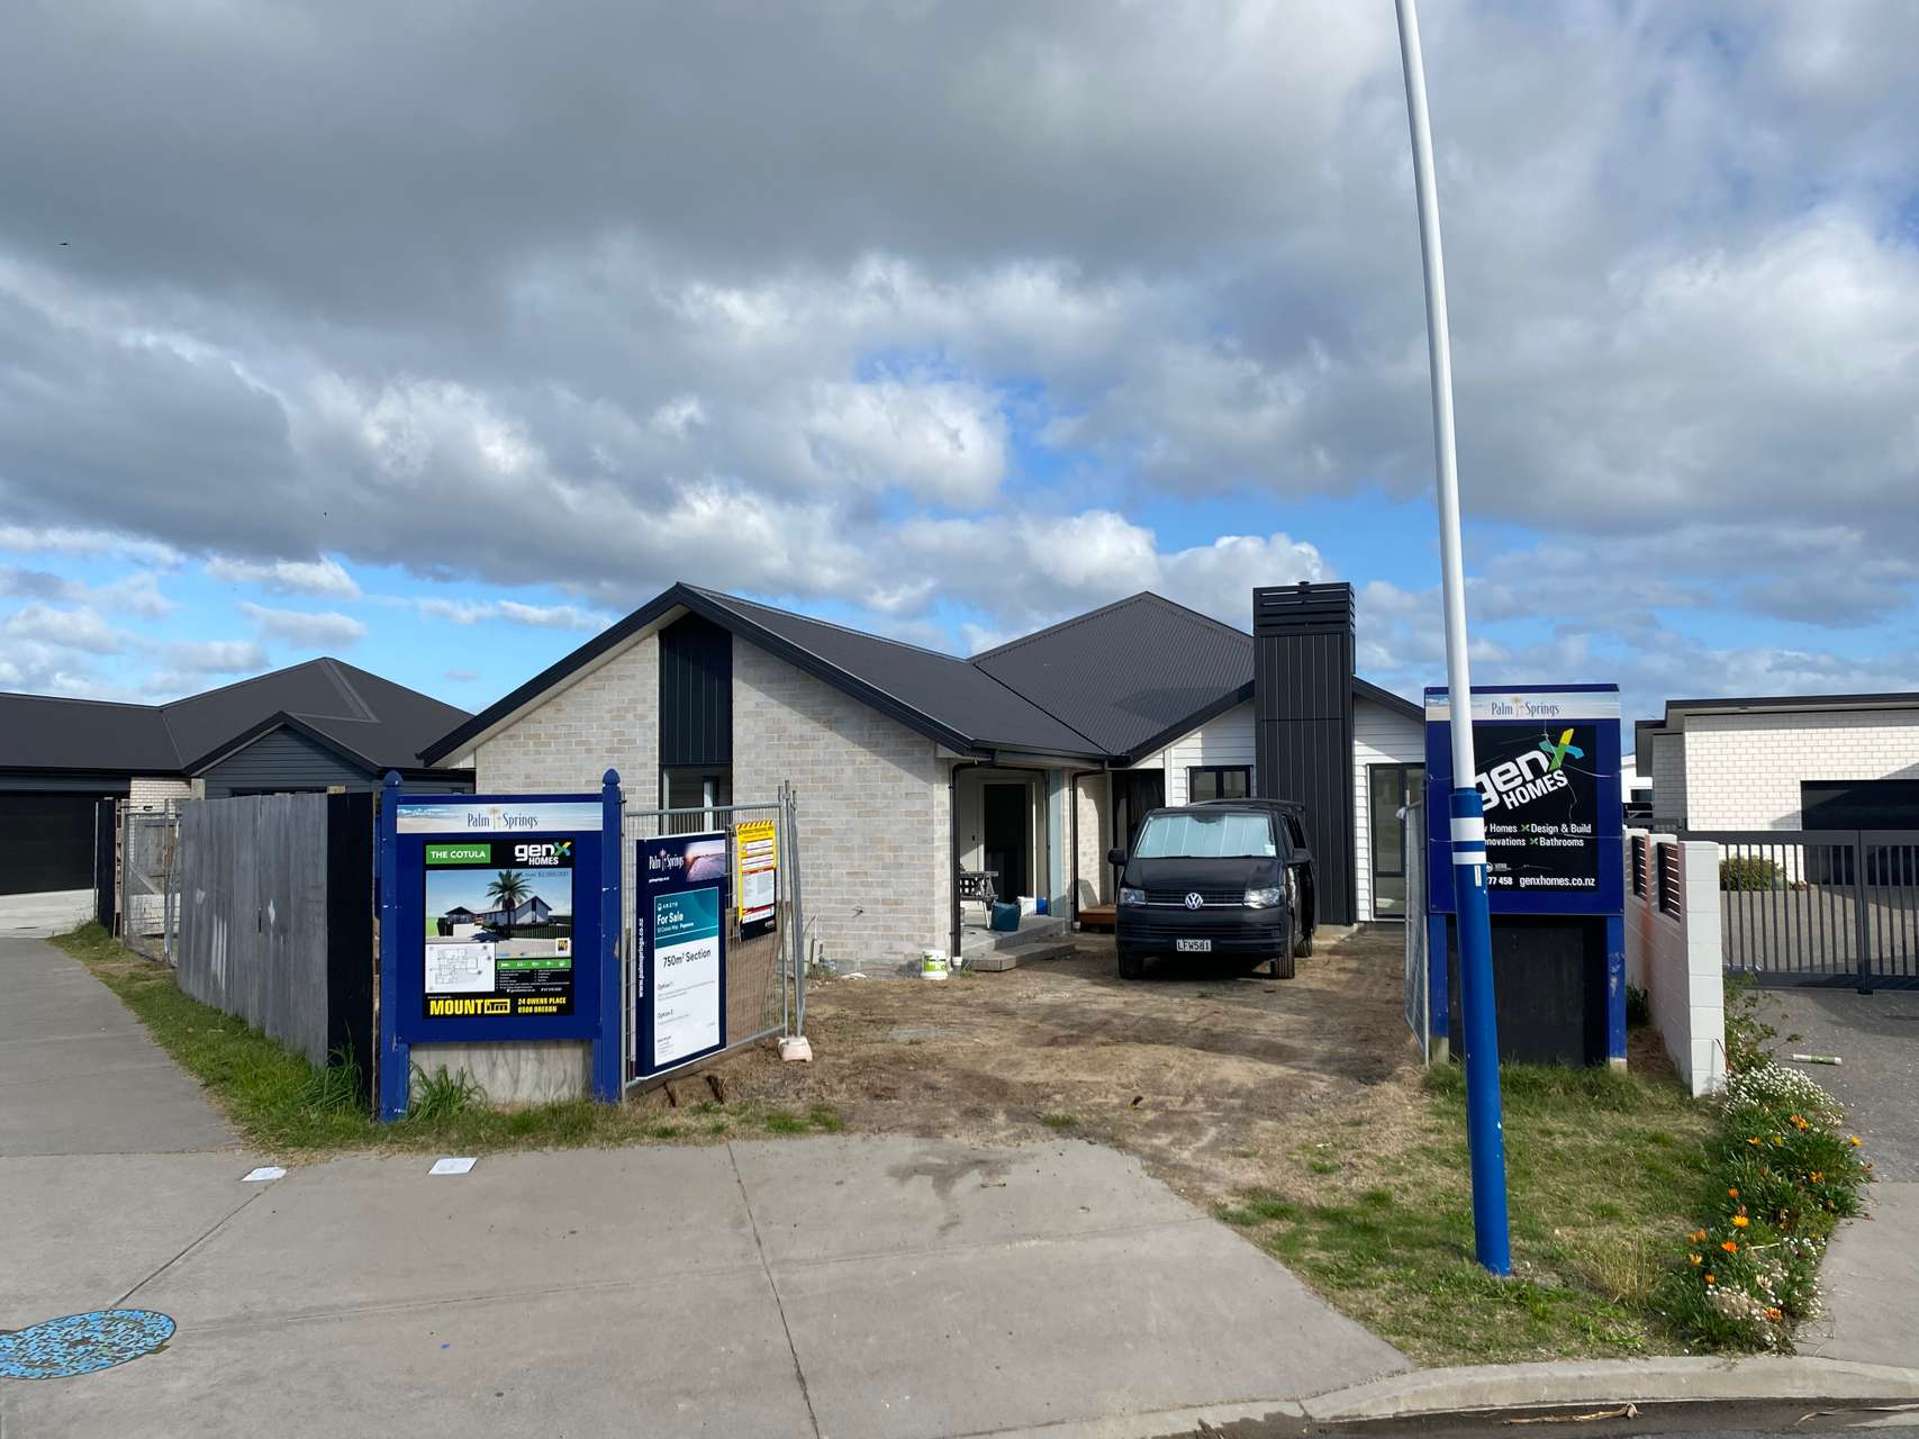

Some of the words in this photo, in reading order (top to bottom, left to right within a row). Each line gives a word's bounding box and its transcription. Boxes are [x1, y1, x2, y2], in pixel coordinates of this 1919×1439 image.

[1491, 702, 1513, 715] Palm
[1525, 702, 1560, 717] Springs
[1502, 769, 1568, 810] HOMES
[467, 812, 490, 827] Palm
[502, 812, 538, 829] Springs
[1489, 823, 1518, 833] Homes
[1530, 824, 1558, 835] Design
[1561, 824, 1568, 833] &
[1570, 824, 1592, 833] Build
[1539, 837, 1584, 846] Bathrooms
[431, 851, 448, 859] THE
[450, 850, 486, 859] COTULA
[528, 856, 560, 865] HOMES
[667, 853, 684, 870] Springs
[1498, 876, 1513, 885] 458
[1519, 875, 1596, 887] genxhomes.co.nz
[657, 914, 669, 925] For
[669, 911, 684, 923] Sale
[685, 947, 712, 962] Section
[429, 999, 484, 1015] MOUNT
[549, 996, 567, 1004] PLACE
